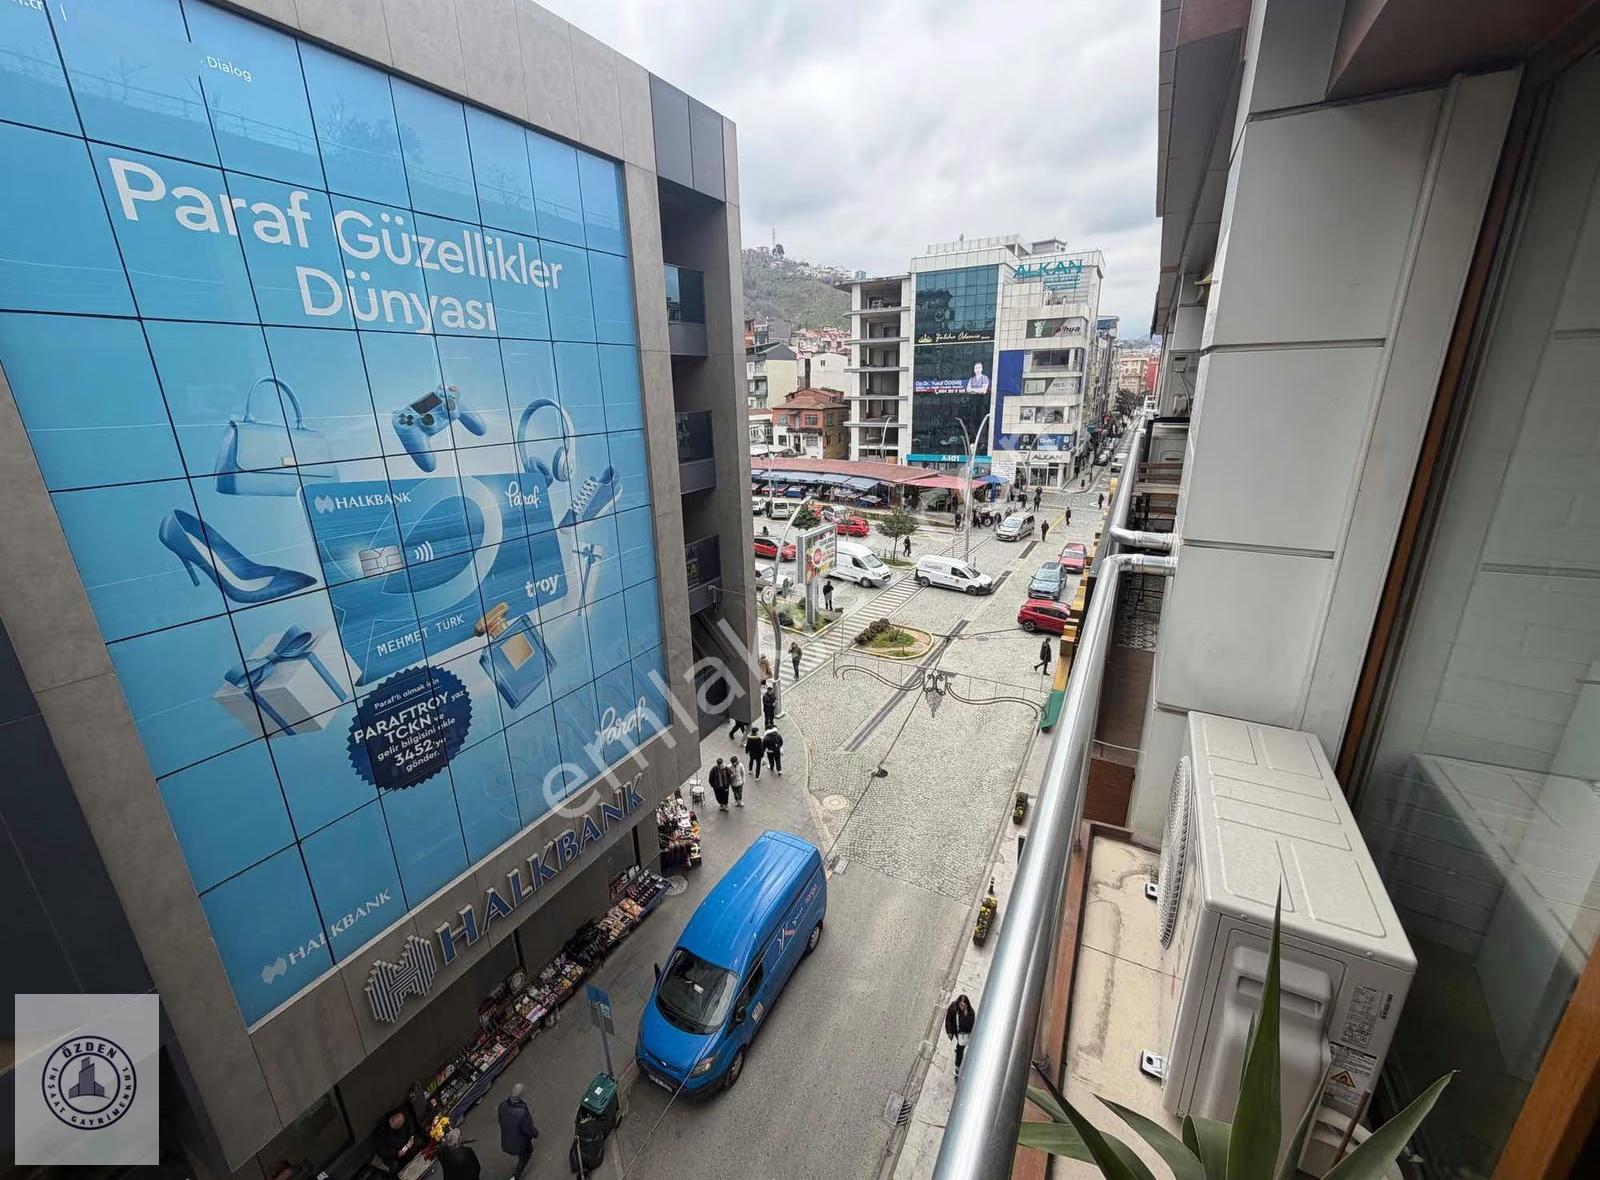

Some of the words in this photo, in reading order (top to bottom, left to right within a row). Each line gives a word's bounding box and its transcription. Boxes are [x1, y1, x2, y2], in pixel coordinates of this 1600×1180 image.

[206, 56, 252, 82] Dialog
[108, 157, 312, 249] Paraf
[332, 209, 563, 291] Güzellikler
[1012, 259, 1083, 279] ALKAN
[295, 266, 497, 335] Dünyası
[335, 491, 412, 510] HALKBANK
[524, 574, 560, 598] troy
[376, 626, 428, 657] MEHMET
[435, 613, 465, 632] TÜRK
[403, 684, 426, 698] olmak
[353, 691, 449, 744] PARAFTROY
[451, 690, 465, 702] yaz
[384, 714, 432, 744] TCKN
[377, 743, 400, 761] gelir
[401, 726, 436, 748] bilgisini
[435, 773, 648, 966] HALKBANK
[288, 888, 391, 965] HALKBANK
